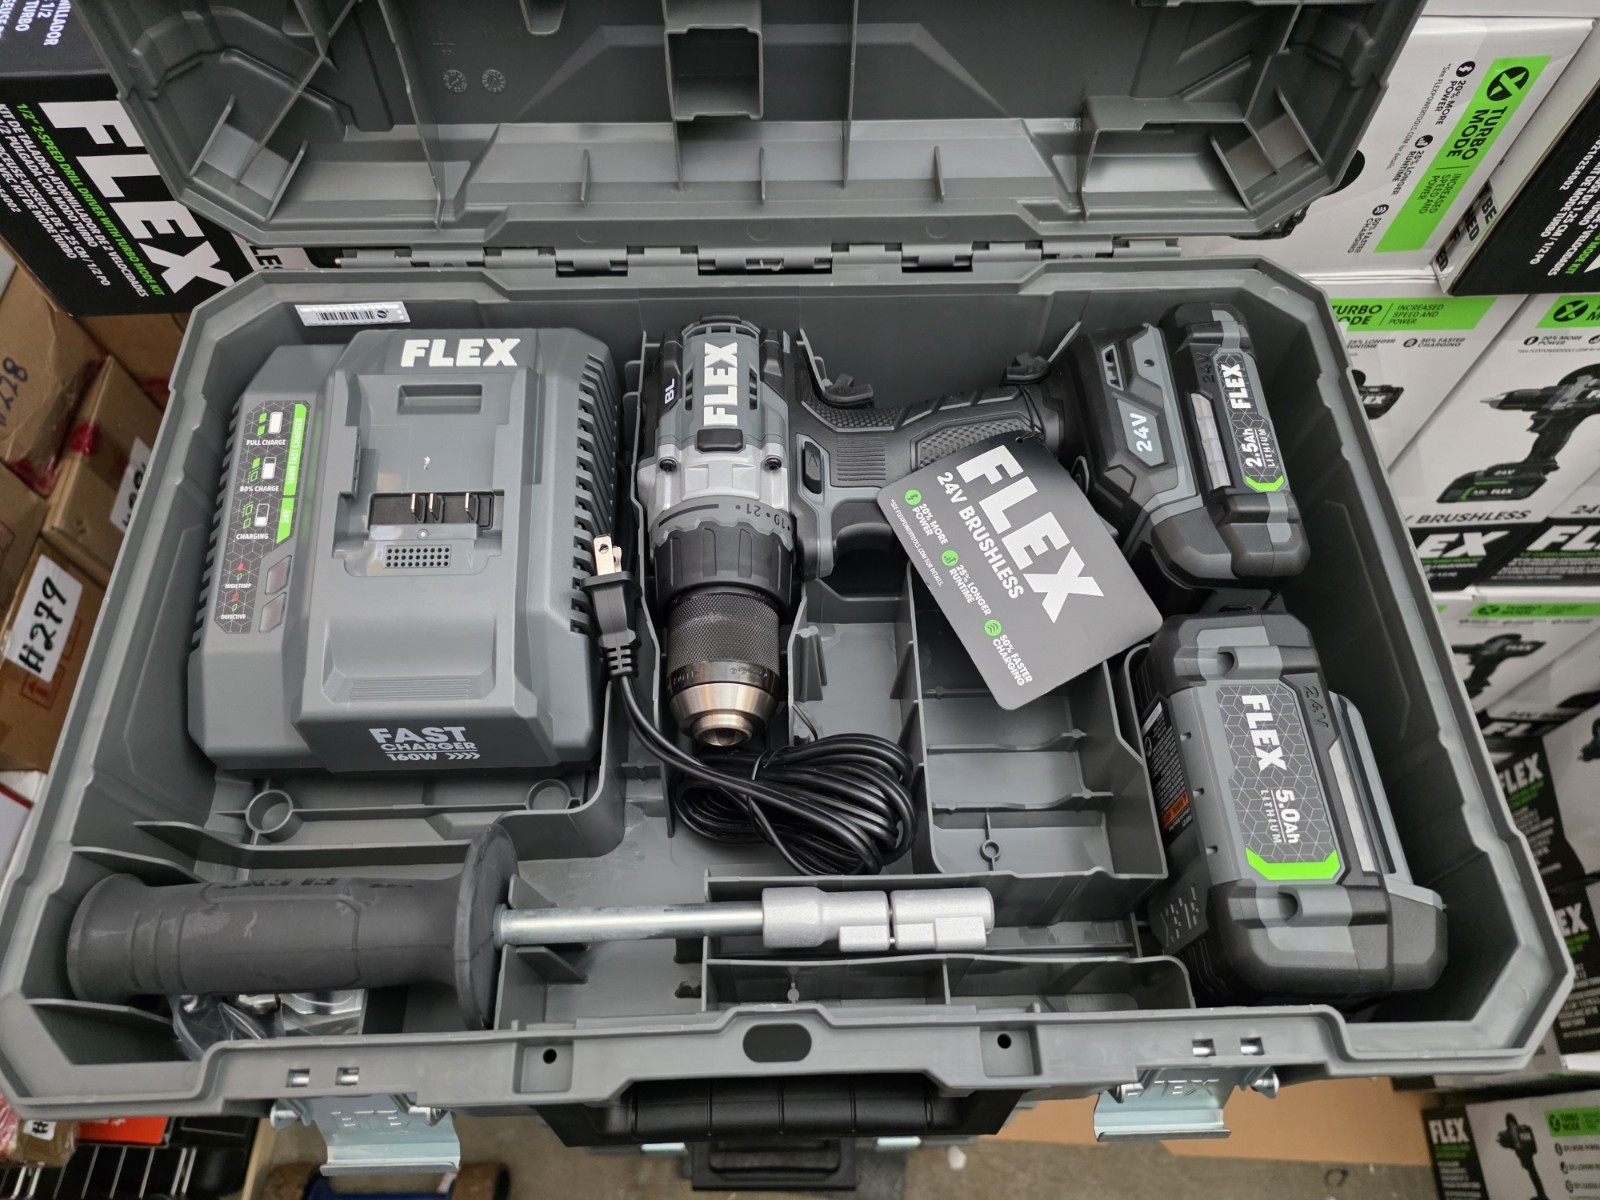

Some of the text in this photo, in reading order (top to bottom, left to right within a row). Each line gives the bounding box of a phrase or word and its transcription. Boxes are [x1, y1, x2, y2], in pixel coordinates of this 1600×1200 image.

[1434, 80, 1457, 112] POWER
[1435, 80, 1466, 126] 20% MORE
[1446, 108, 1484, 158] MODE
[1461, 105, 1508, 161] TURBO
[1390, 166, 1414, 195] LONGER
[1392, 150, 1416, 182] RUNTIME
[1580, 176, 1597, 187] DE
[4, 135, 43, 177] PULGADA
[37, 177, 59, 195] CON
[51, 196, 78, 222] MODO
[72, 221, 98, 248] TURBO
[38, 100, 236, 294] FLEX
[1416, 175, 1441, 200] POWER
[1418, 174, 1451, 214] SPEED AND
[1428, 173, 1462, 214] INCREASED
[1560, 187, 1587, 212] MODE
[1577, 194, 1594, 205] DE
[7, 120, 26, 134] DE
[18, 133, 55, 175] TALADRO
[47, 174, 102, 235] ATORNILLADOR
[95, 234, 110, 245] DE
[107, 250, 149, 298] VELOCIDADES
[10, 184, 30, 198] KIT
[21, 198, 39, 210] DE
[31, 210, 58, 234] MODE
[51, 234, 77, 259] TURBO
[32, 125, 66, 162] 2-SPEED
[59, 163, 83, 187] DRILL
[77, 187, 107, 217] DRIVER
[100, 217, 122, 237] WITH
[115, 237, 140, 262] TURBO
[133, 262, 157, 284] MODE
[150, 284, 165, 296] KIT
[1540, 211, 1568, 237] TURBO
[1551, 224, 1568, 237] CM
[49, 216, 66, 228] DE
[73, 246, 91, 259] CM
[87, 262, 103, 276] 1/2
[95, 275, 111, 286] PO
[1529, 254, 1545, 265] PO
[1547, 229, 1594, 276] VELOCIDADES
[1564, 263, 1581, 275] KIT
[401, 338, 520, 368] FLEX
[664, 378, 675, 404] BL
[703, 342, 738, 426] FLEX
[1221, 363, 1251, 409] FLEX
[1129, 412, 1153, 452] 24V
[1241, 428, 1263, 468] 2.5Ah
[1257, 428, 1276, 468] LITHIUM
[745, 503, 761, 517] 21
[912, 506, 933, 536] POWER
[919, 503, 949, 545] 20% MORE
[1416, 510, 1531, 524] BRUSHLESS
[895, 509, 928, 560] FLEXPOWERTOOLS.COM
[936, 471, 1024, 599] 24V BRUSHLESS
[956, 444, 1104, 623] FLEX
[1416, 531, 1510, 557] EX
[1526, 525, 1600, 550] FL
[949, 567, 975, 604] RUNTIME
[956, 564, 992, 616] 25% LONGER
[992, 638, 1025, 686] CHARGING
[999, 634, 1033, 684] 50% FASTER
[1304, 685, 1329, 728] 24V
[368, 726, 466, 743] FAST
[380, 741, 478, 751] CHARGER
[1241, 694, 1287, 771] FLEX
[387, 753, 437, 761] 160W
[1260, 789, 1283, 844] LITHIUM
[1275, 789, 1301, 844] 5.0Ah
[1428, 1117, 1470, 1144] FLEX
